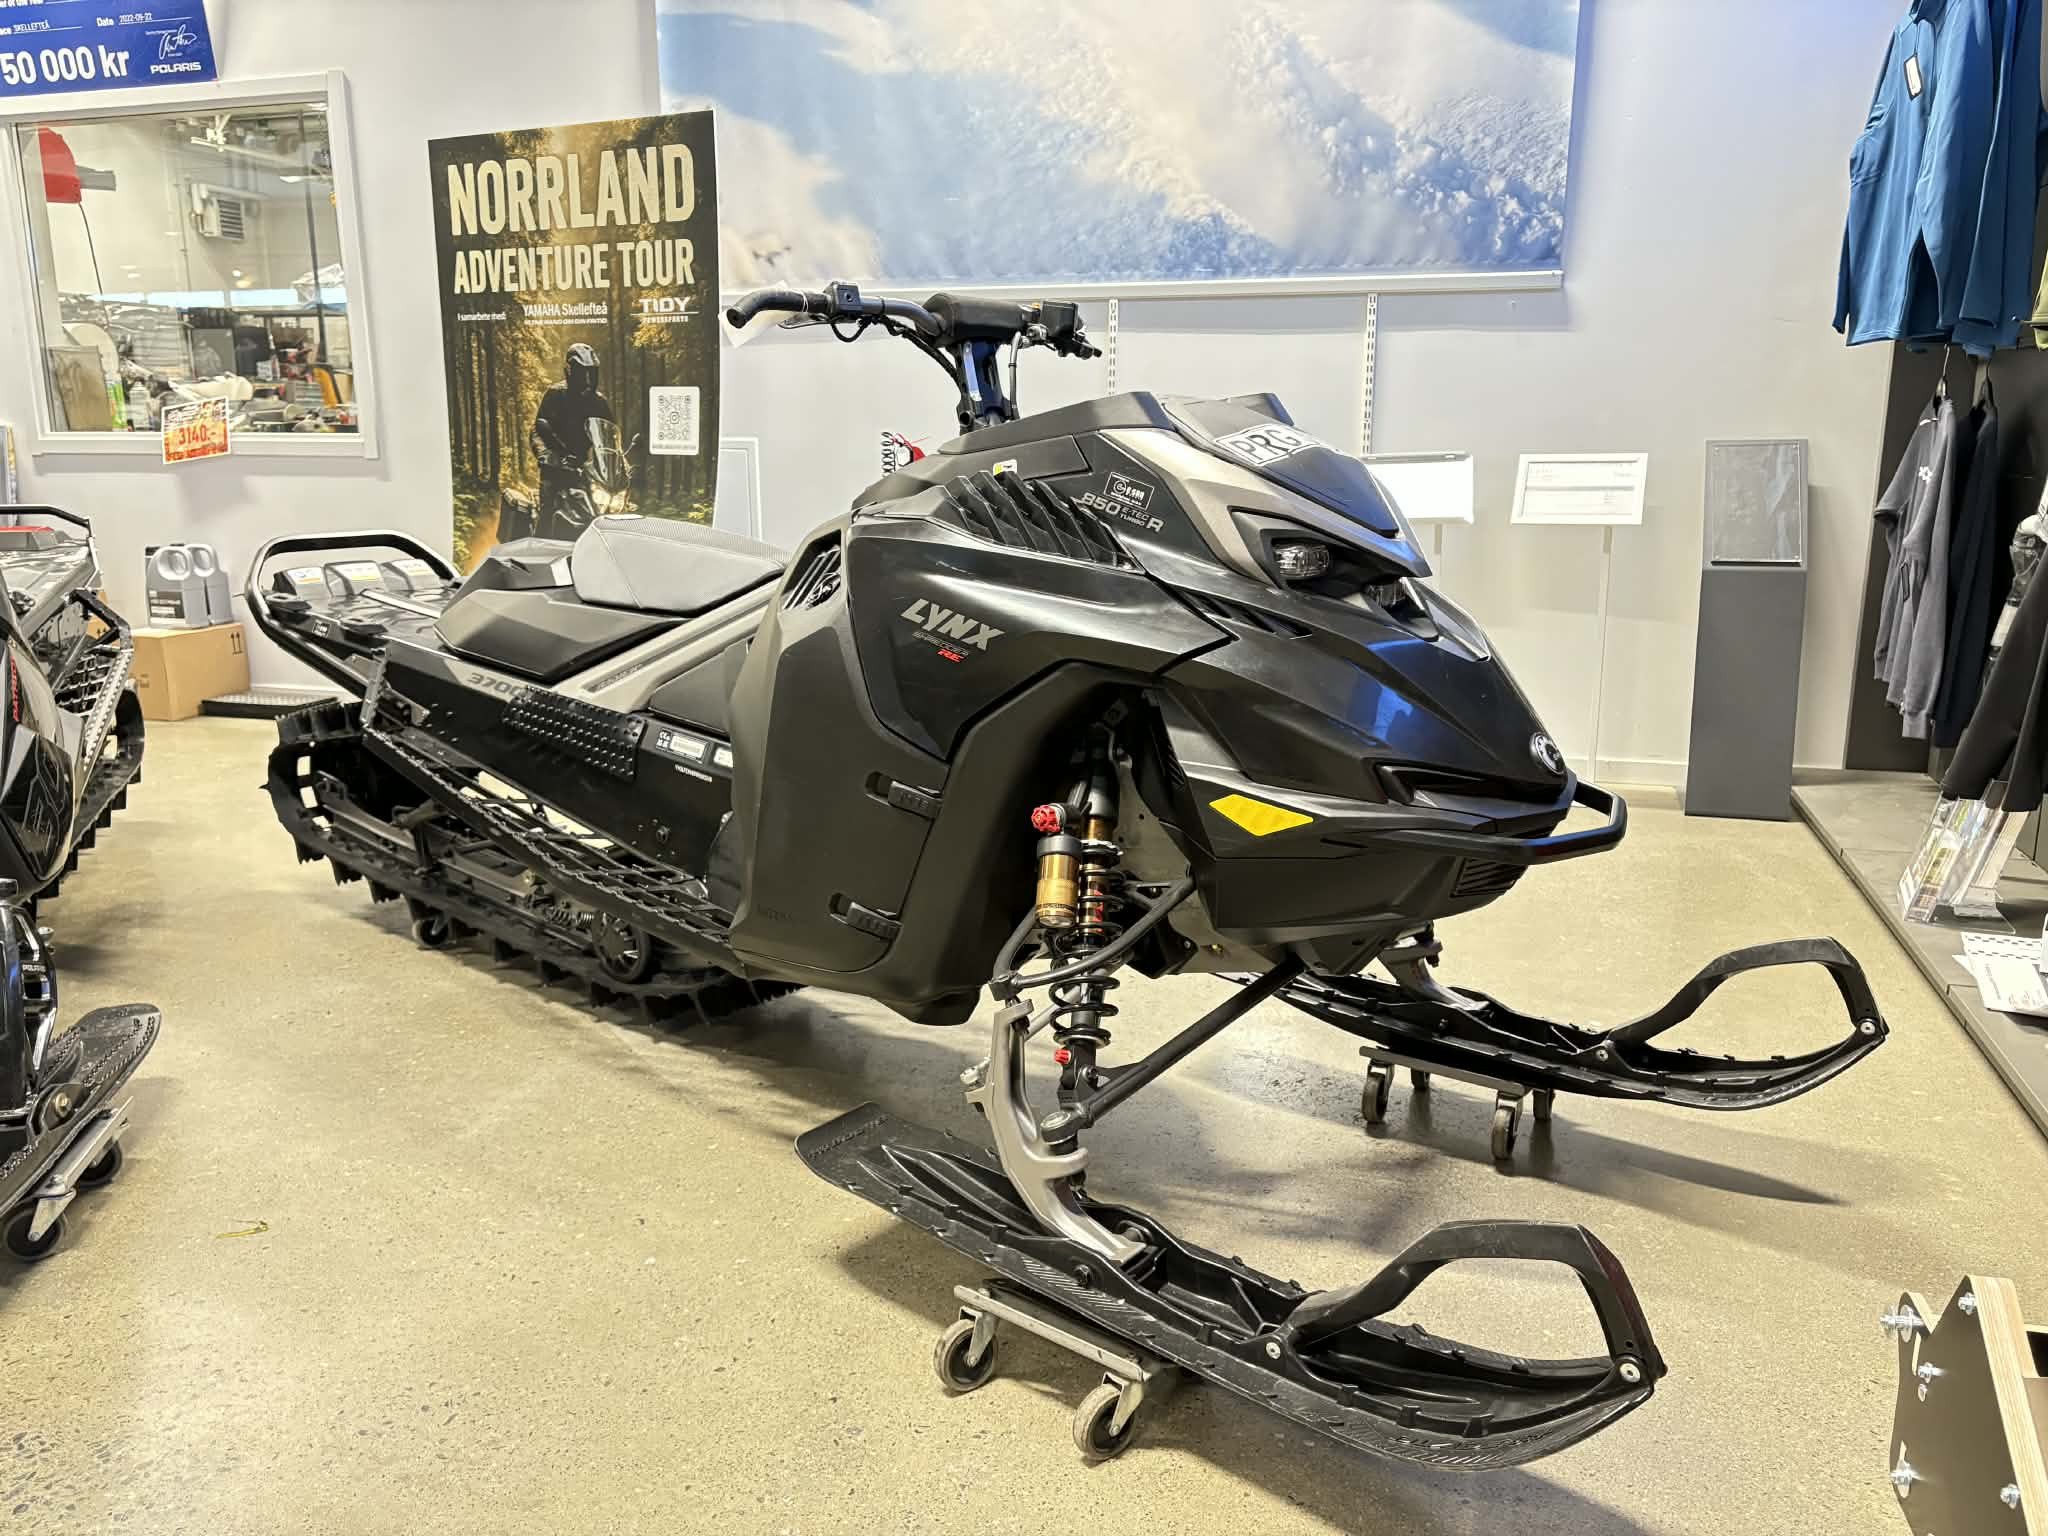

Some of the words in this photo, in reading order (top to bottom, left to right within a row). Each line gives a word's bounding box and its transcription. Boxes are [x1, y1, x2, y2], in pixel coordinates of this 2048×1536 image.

[96, 17, 114, 27] Date
[40, 46, 96, 83] 000
[98, 44, 129, 78] kr
[150, 61, 201, 74] POLARIS
[447, 143, 696, 236] NORRLAND
[453, 239, 610, 294] ADVENTURE
[617, 238, 695, 287] TOUR
[523, 303, 560, 316] YAMAHA
[561, 301, 608, 315] Skellefteå
[639, 296, 690, 312] TIDY
[1081, 492, 1121, 516] 850
[1121, 507, 1149, 521] E-TEC
[1146, 517, 1165, 532] R
[900, 598, 1006, 652] LYNX
